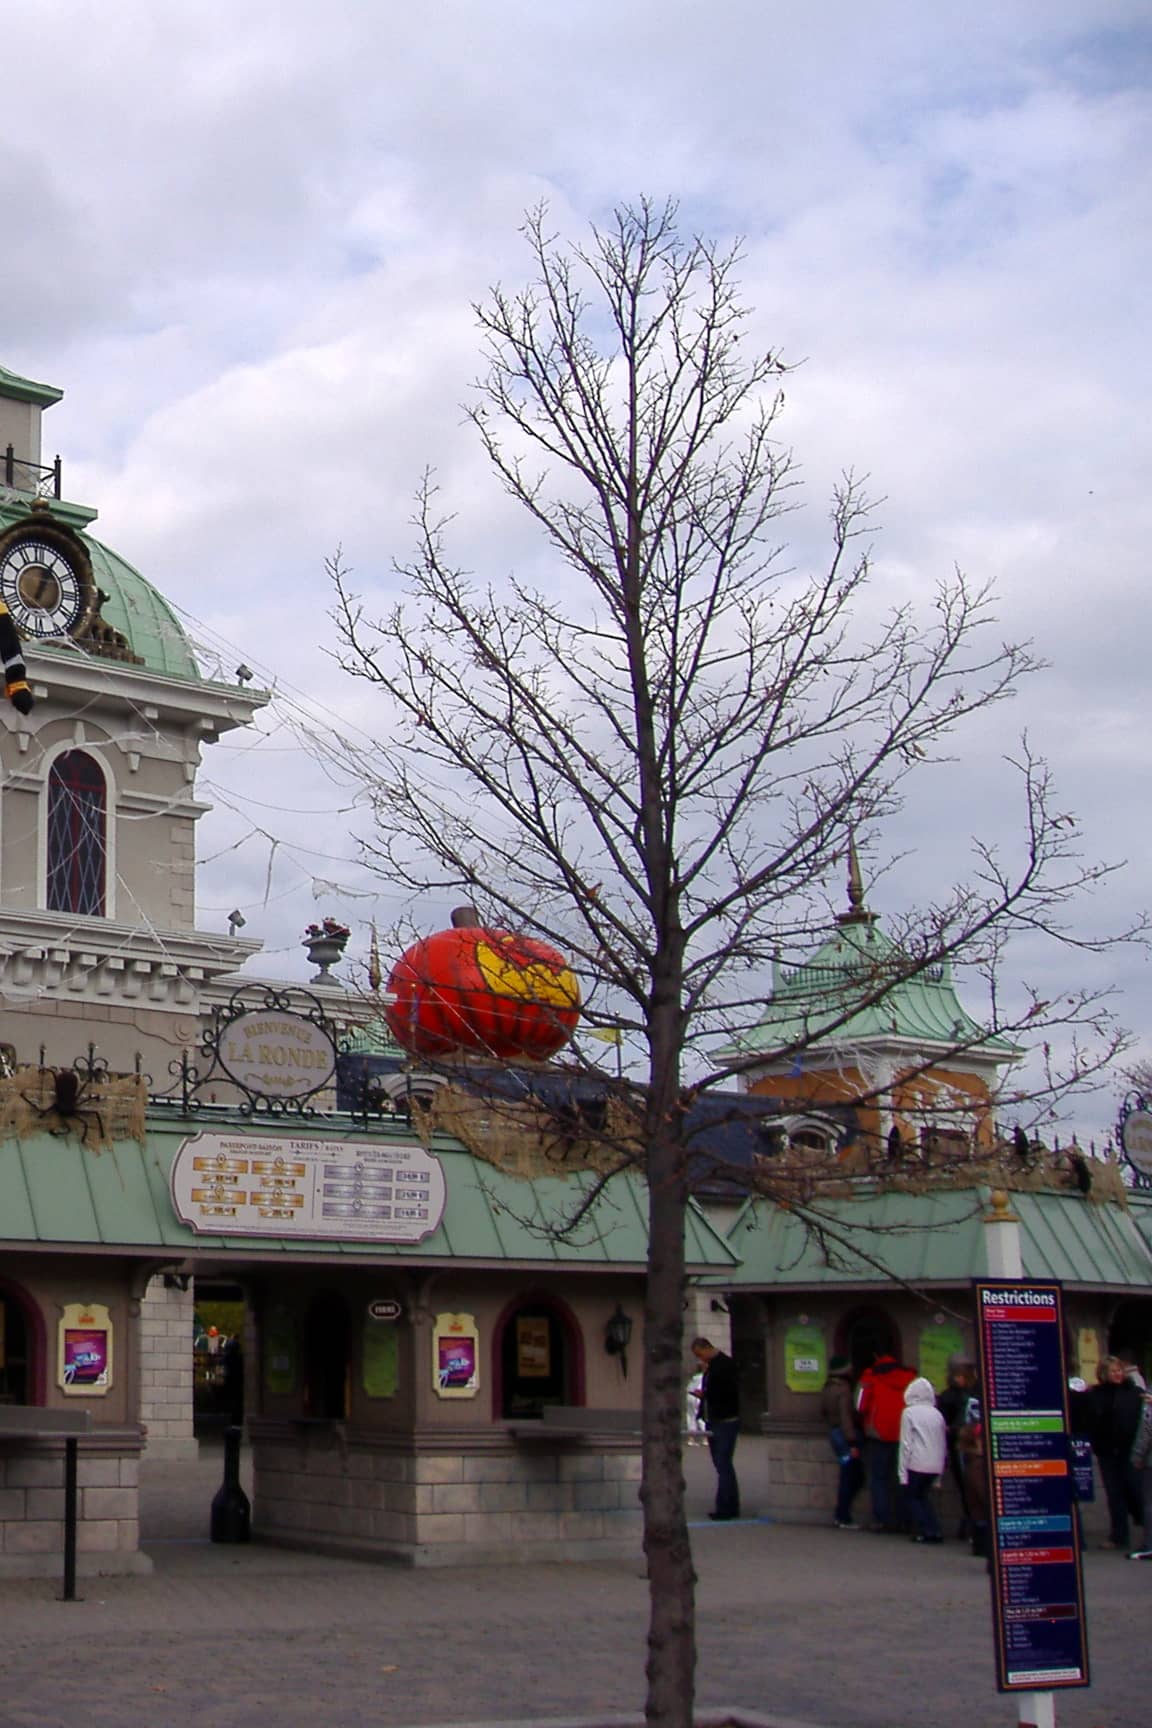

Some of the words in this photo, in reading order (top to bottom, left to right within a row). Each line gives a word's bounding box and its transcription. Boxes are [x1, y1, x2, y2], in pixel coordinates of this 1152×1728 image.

[228, 1041, 254, 1063] LA
[259, 1044, 328, 1070] RONDE
[982, 1290, 1056, 1306] Restrictions
